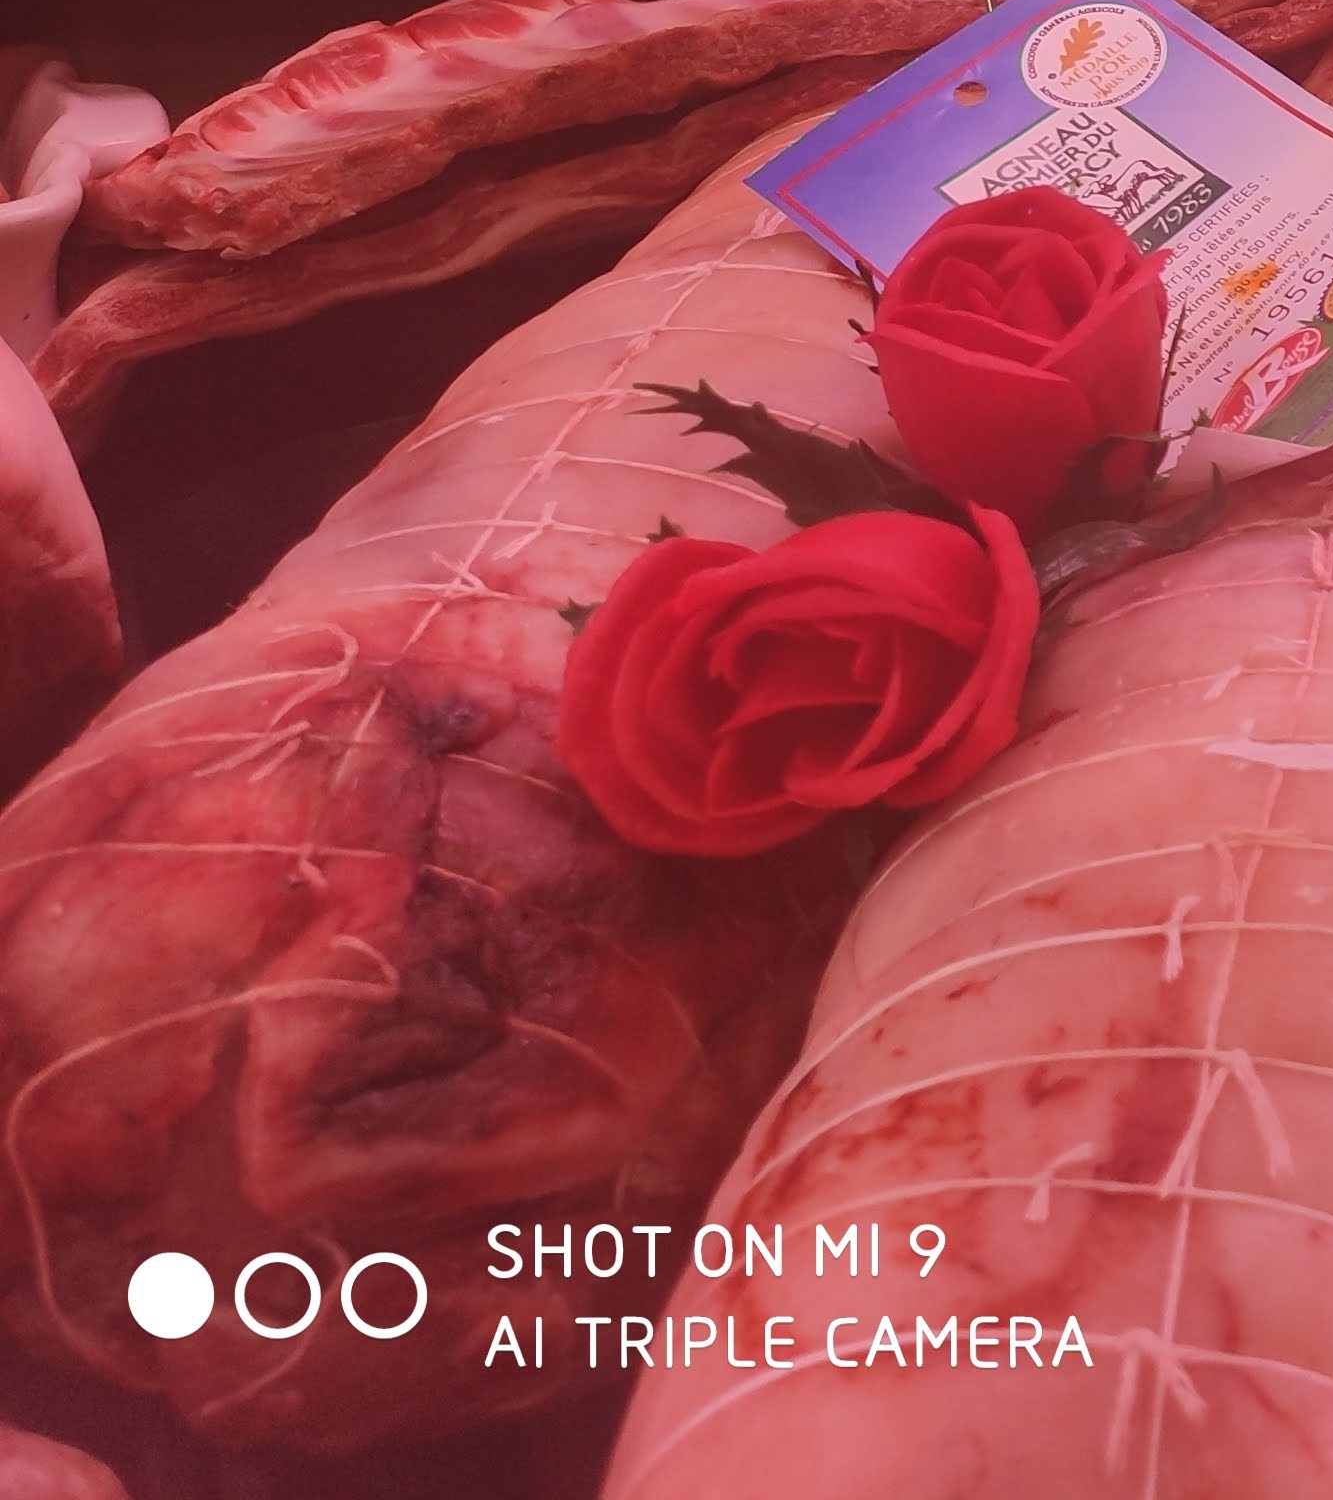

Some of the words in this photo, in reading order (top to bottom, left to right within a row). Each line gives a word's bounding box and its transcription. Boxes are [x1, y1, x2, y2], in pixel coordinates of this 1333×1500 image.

[981, 111, 1099, 198] AGNEAU
[1082, 121, 1118, 149] DU
[1051, 139, 1122, 194] ERCY
[1152, 182, 1212, 235] 1983
[1188, 181, 1260, 242] CERTIFIÉES
[1183, 255, 1204, 280] par
[1237, 213, 1254, 228] au
[1253, 194, 1272, 215] pis
[1227, 260, 1244, 276] de
[1241, 238, 1267, 259] 150
[1268, 232, 1298, 266] point
[1297, 217, 1313, 232] de
[1167, 284, 1195, 311] oins
[1215, 236, 1249, 268] jours
[1177, 352, 1199, 370] Né
[1199, 338, 1214, 352] et
[1213, 307, 1246, 338] élevé
[1244, 292, 1261, 308] en
[1161, 376, 1194, 408] usqu'à
